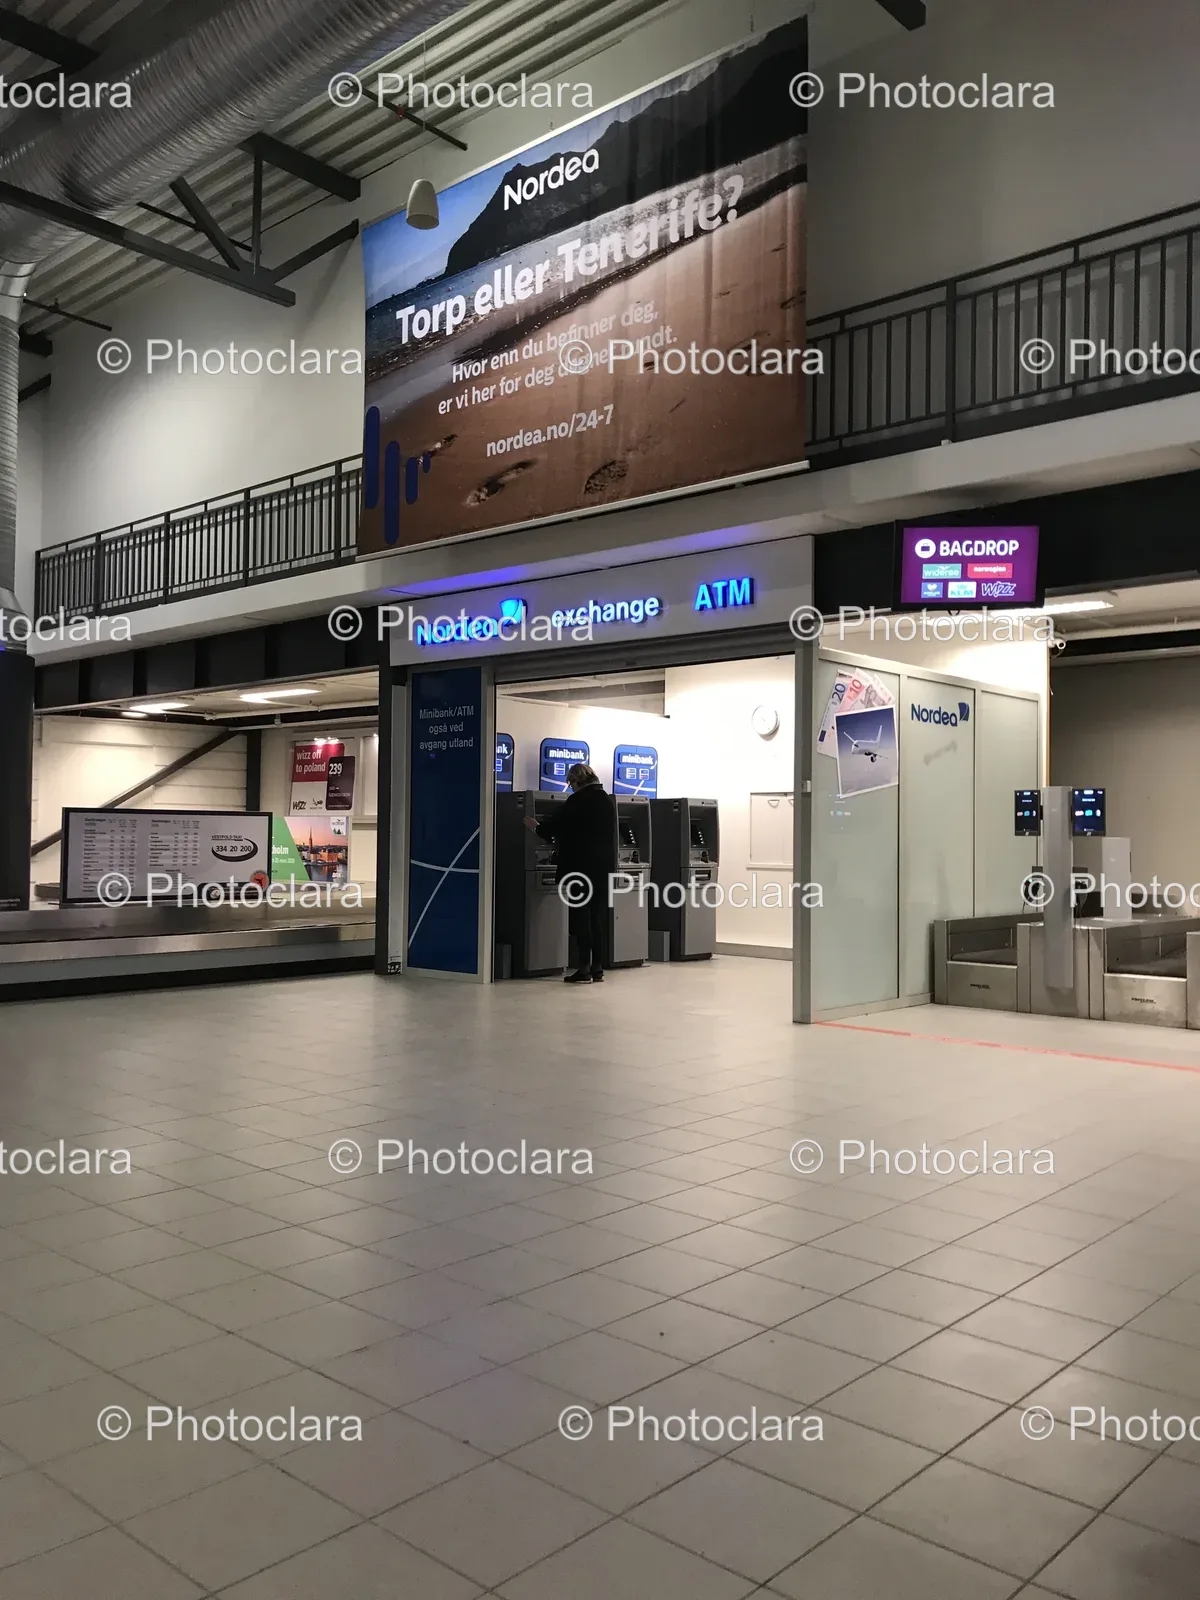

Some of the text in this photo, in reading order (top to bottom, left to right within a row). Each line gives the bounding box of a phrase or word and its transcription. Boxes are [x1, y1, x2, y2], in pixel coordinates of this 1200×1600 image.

[503, 149, 600, 211] Nordea
[396, 174, 745, 346] Torp eller Tenerife?
[452, 301, 659, 384] Hvor enn du befinner deg,
[438, 396, 453, 415] er
[455, 389, 468, 410] vi
[471, 382, 497, 405] her
[499, 374, 522, 397] for
[525, 362, 555, 388] deg
[486, 404, 615, 457] nordea.no/24-7
[939, 540, 1020, 557] BAGDROP
[694, 577, 753, 612] ATM
[551, 596, 661, 629] exchange
[415, 616, 498, 646] Nordea
[419, 705, 474, 720] Minibank/ATM
[911, 703, 958, 727] Nordea
[428, 722, 464, 735] også ved
[296, 748, 323, 760] wizz off
[419, 737, 474, 751] avgang utland
[549, 748, 585, 760] minibank
[295, 761, 326, 774] to poland
[328, 763, 342, 775] 239
[622, 754, 654, 765] minibank
